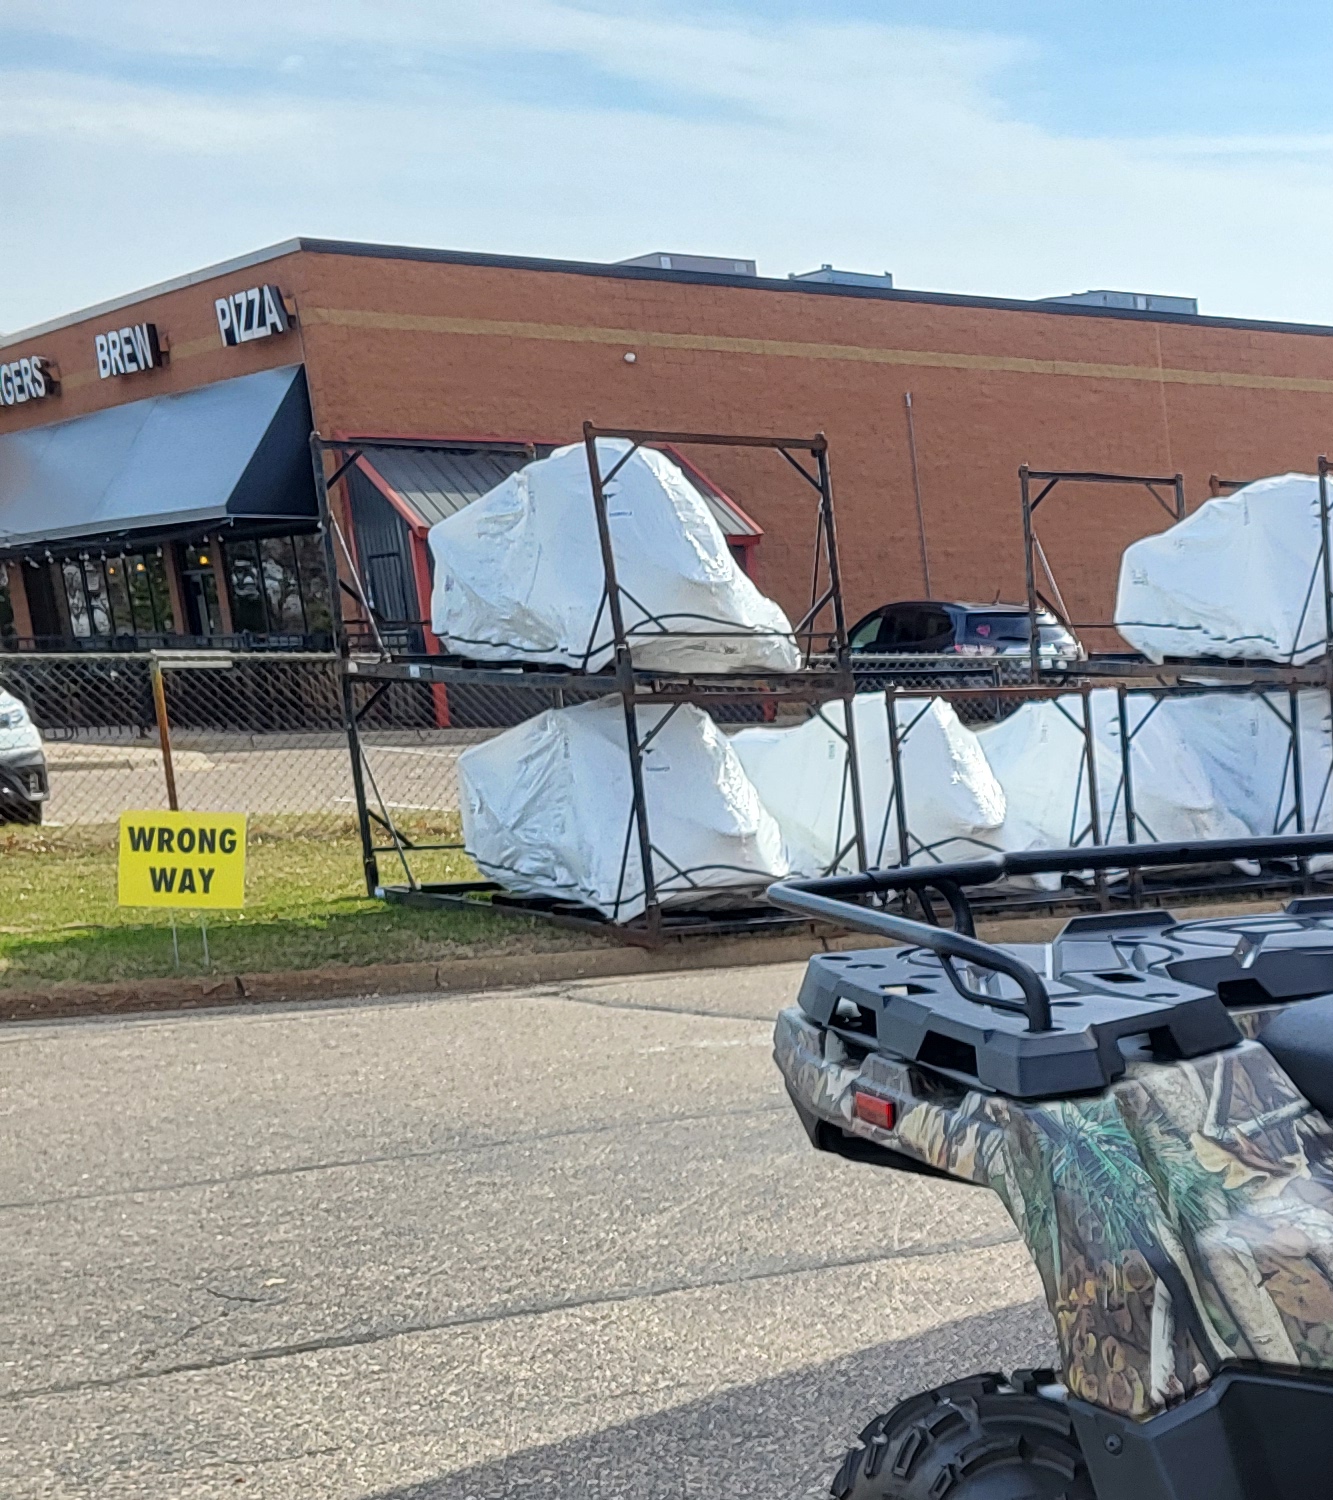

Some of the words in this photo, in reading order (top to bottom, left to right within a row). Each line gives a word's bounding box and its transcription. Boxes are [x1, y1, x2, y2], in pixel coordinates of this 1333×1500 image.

[95, 323, 153, 379] BREW
[215, 284, 283, 347] PIZZA
[127, 826, 237, 854] WRONG
[149, 866, 215, 894] WAY
